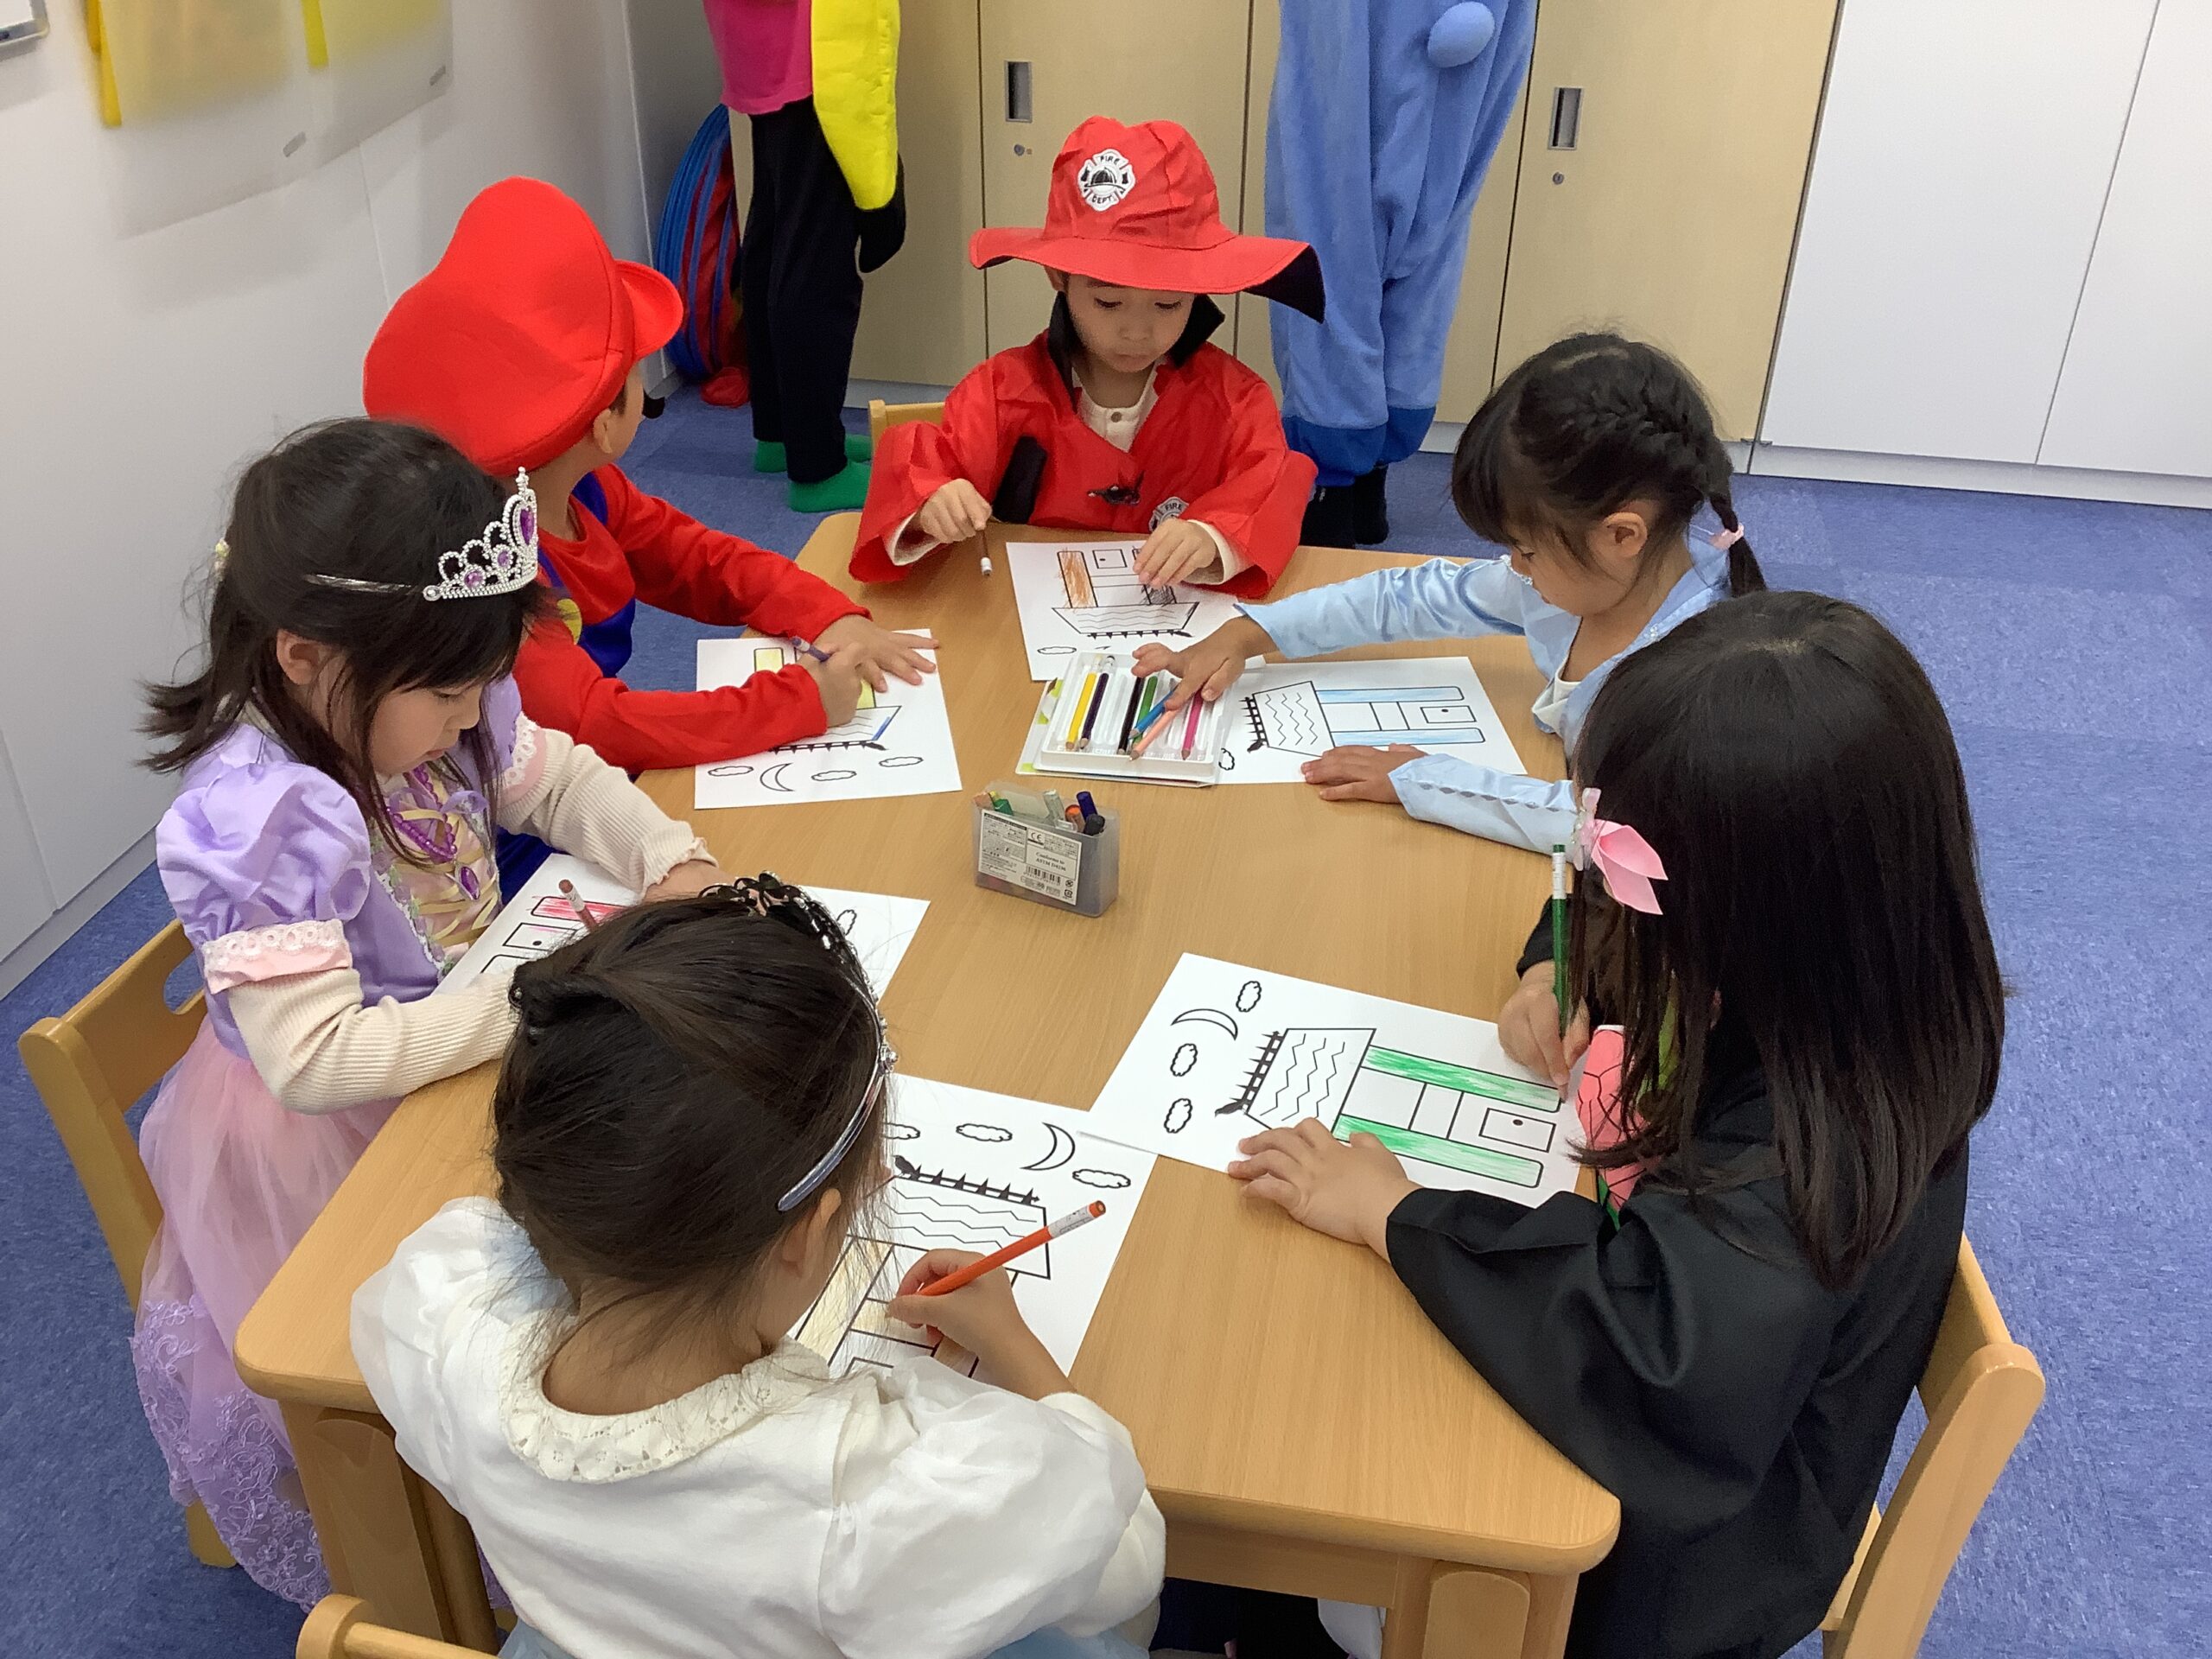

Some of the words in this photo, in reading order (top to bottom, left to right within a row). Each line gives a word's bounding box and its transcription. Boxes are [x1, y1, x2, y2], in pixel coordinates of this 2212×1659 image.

[1100, 156, 1121, 165] FIRE
[1091, 194, 1112, 204] DEPT
[1165, 502, 1182, 511] FIRE
[1031, 832, 1042, 842] CE
